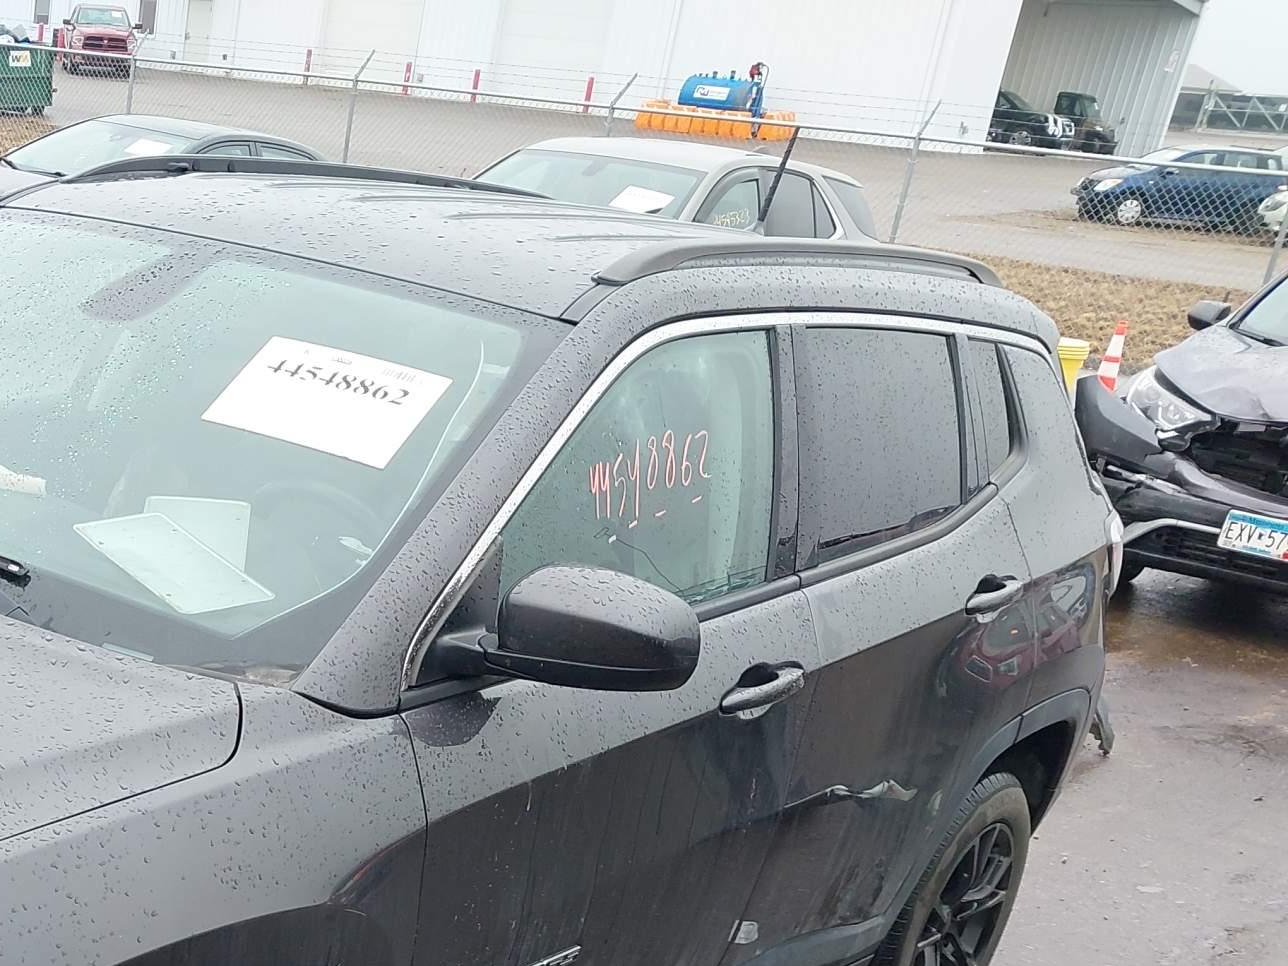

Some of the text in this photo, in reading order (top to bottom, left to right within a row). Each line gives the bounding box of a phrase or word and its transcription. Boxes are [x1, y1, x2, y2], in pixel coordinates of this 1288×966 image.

[267, 359, 410, 406] 44548862
[589, 428, 713, 520] 44548862
[1224, 521, 1258, 544] EXV
